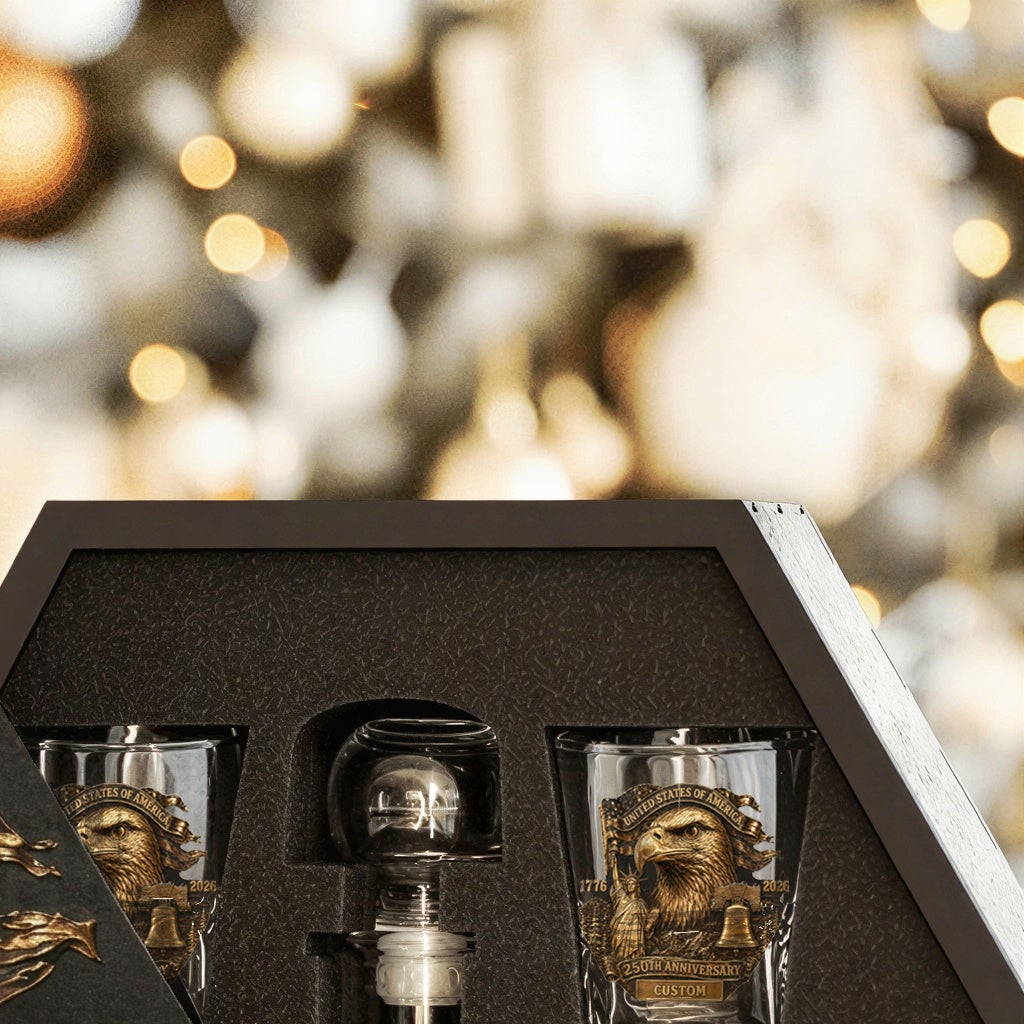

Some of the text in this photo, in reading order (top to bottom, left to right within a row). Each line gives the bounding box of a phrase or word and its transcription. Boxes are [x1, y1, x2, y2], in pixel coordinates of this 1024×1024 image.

[82, 787, 117, 805] STATES
[120, 789, 133, 800] OF
[133, 793, 170, 826] AMERICA
[623, 787, 745, 826] UNITED STATES OF AMERICA
[189, 880, 217, 892] 2026
[579, 880, 607, 892] 1776
[763, 880, 789, 892] 2026
[624, 959, 741, 976] 250TH ANNIVERSARY
[654, 984, 707, 997] CUSTOM
